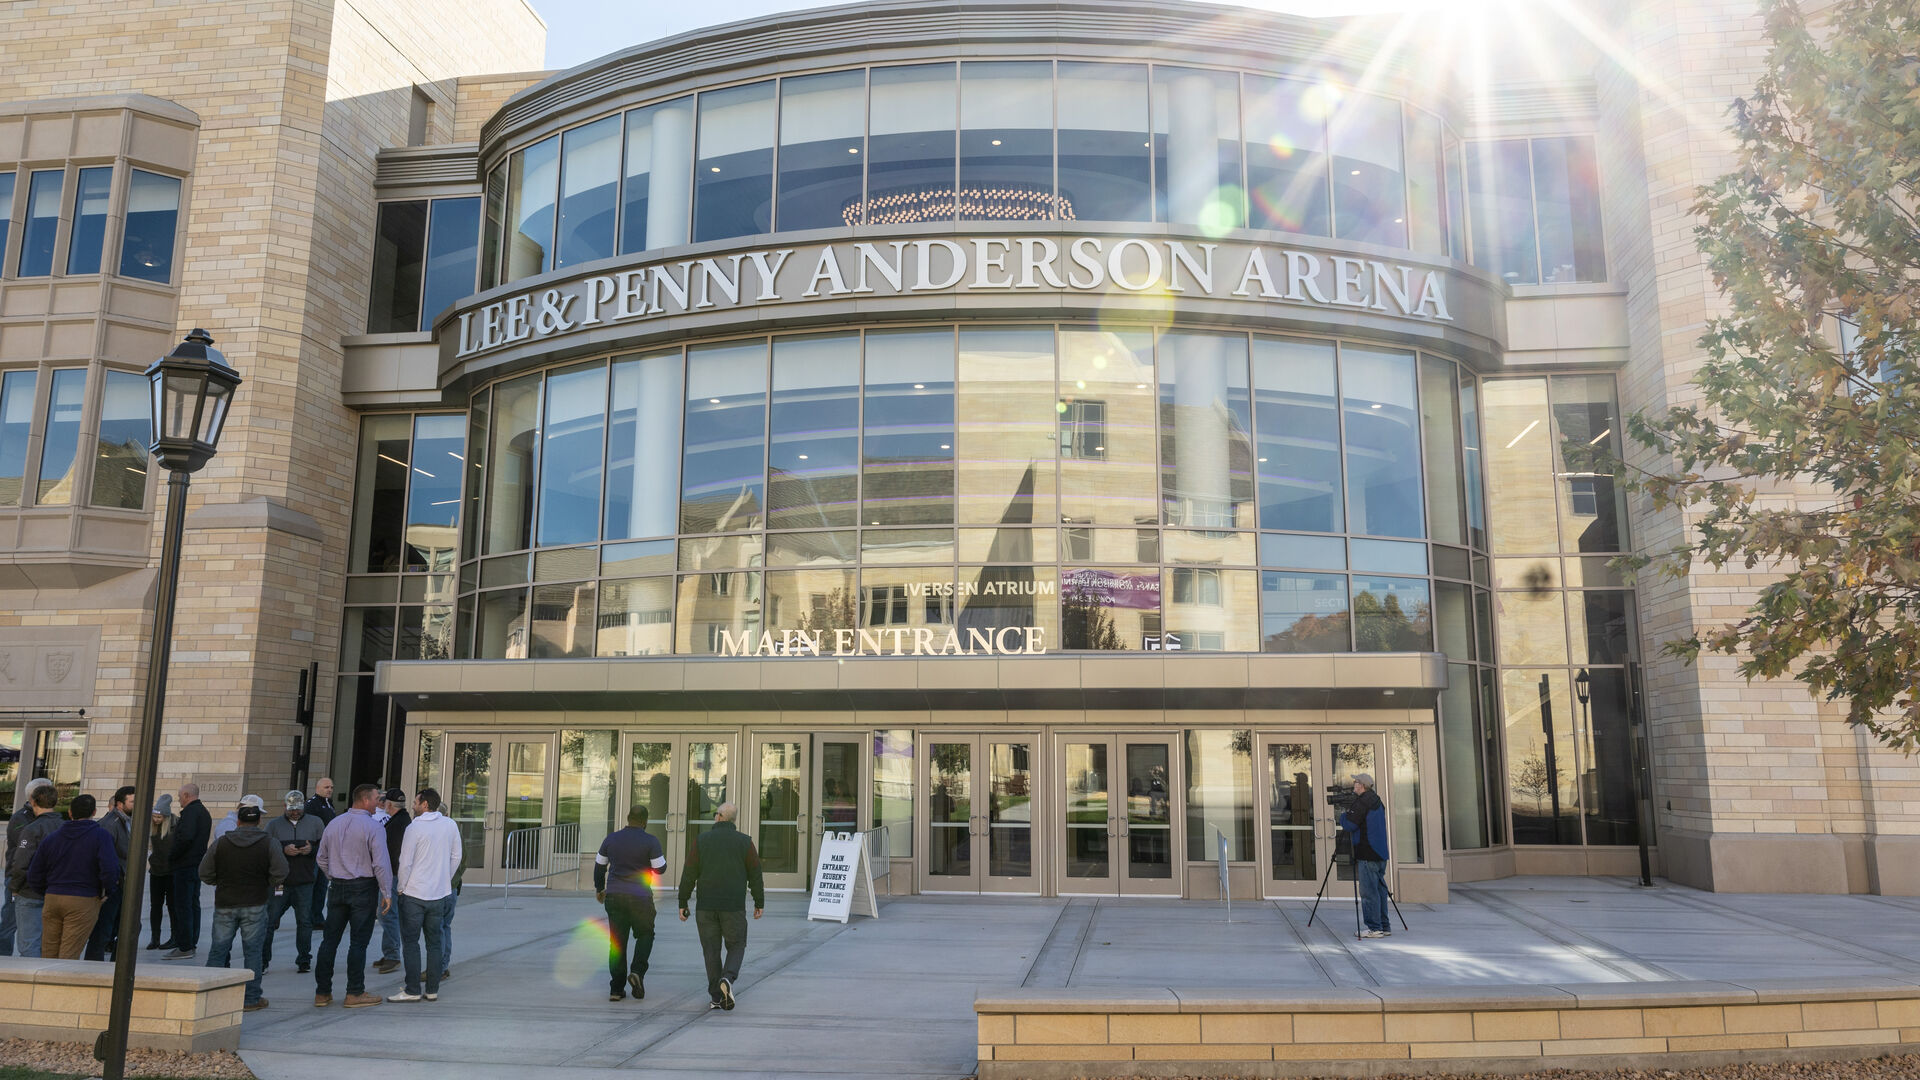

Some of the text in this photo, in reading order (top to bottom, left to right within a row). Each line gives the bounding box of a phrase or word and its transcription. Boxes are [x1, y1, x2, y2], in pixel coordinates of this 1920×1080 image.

[455, 237, 1454, 359] LEE & PENNY ANDERSON ARENA
[904, 581, 1055, 597] IVERSEN ATRIUM
[718, 626, 1047, 657] MAIN ENTRANCE
[218, 784, 238, 792] 2025
[822, 873, 846, 881] REUBEN'S
[819, 882, 845, 890] ENTRANCE
